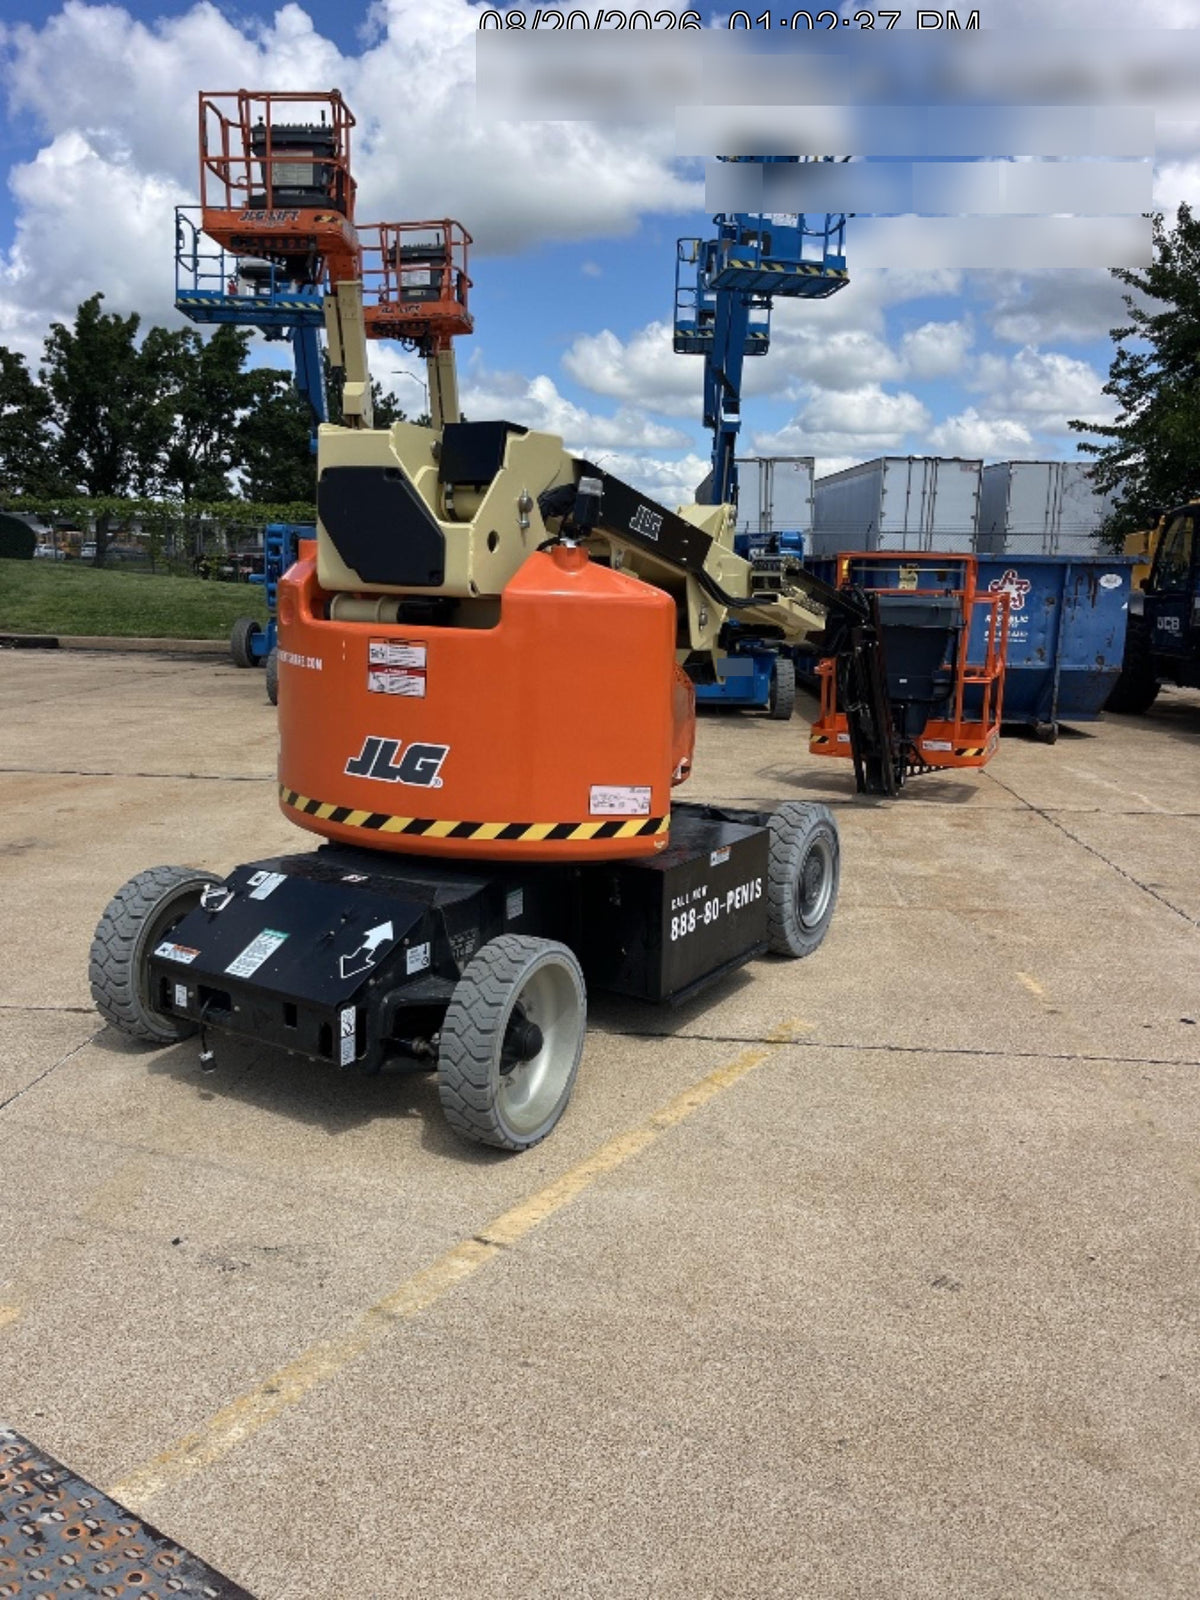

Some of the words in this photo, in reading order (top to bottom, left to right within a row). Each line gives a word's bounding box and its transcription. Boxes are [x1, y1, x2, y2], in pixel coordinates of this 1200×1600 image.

[629, 504, 664, 541] JLG
[1157, 616, 1180, 630] JCB
[344, 735, 450, 787] JLG
